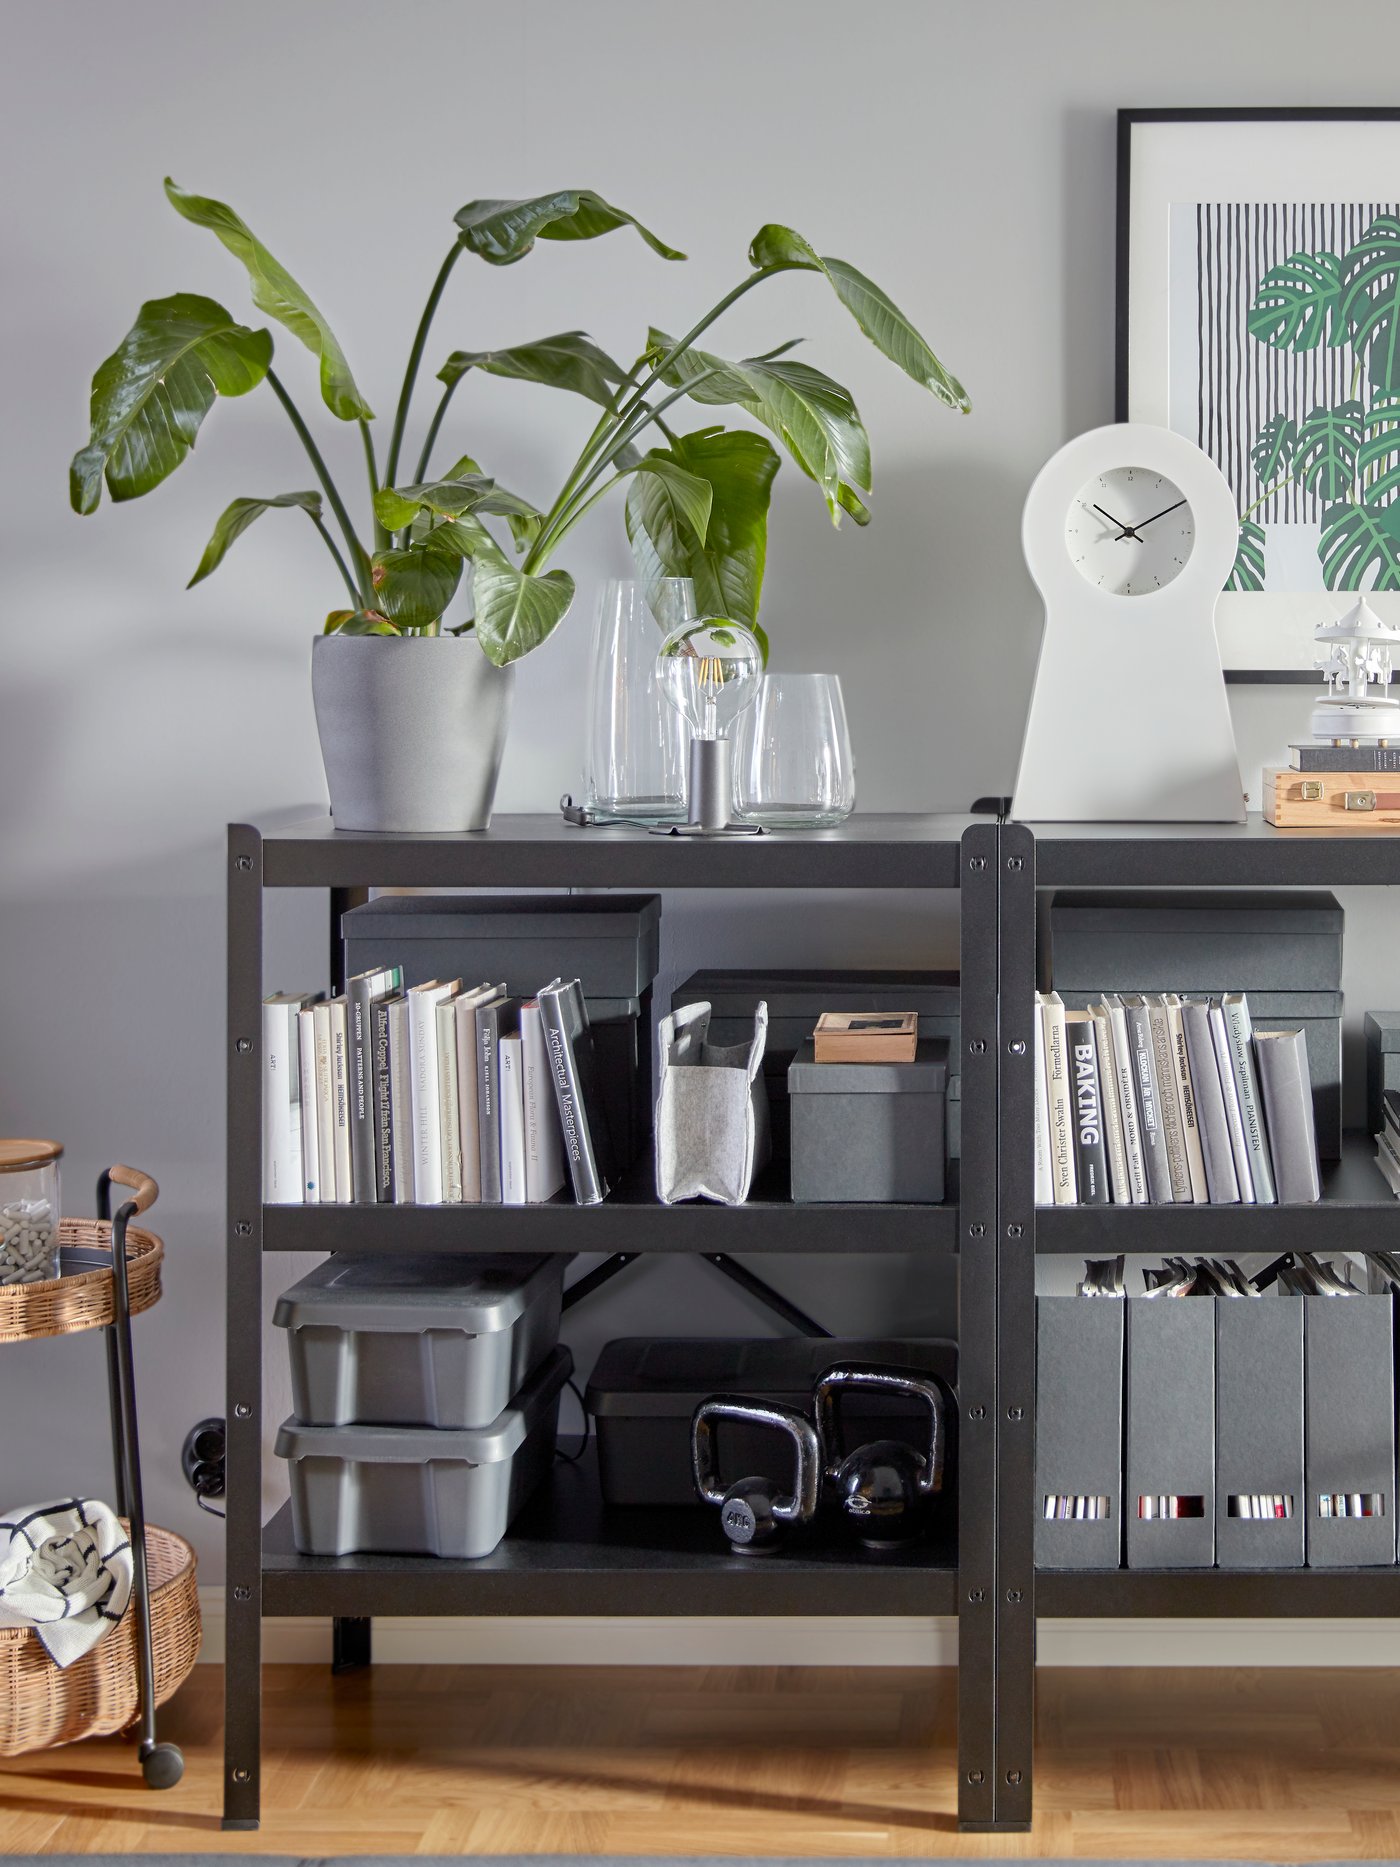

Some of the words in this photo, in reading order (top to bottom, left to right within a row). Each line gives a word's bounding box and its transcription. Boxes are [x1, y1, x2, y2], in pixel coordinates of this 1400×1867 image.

[355, 1002, 363, 1040] 10-GRUPPEN
[378, 1010, 389, 1038] Alfred
[1151, 1018, 1167, 1043] ansikte
[482, 1028, 491, 1045] Följa
[1176, 1033, 1187, 1055] Shirley
[1139, 1052, 1150, 1083] KLOCKAN
[1179, 1056, 1188, 1081] Jackson
[379, 1074, 390, 1100] Flight
[526, 1066, 536, 1100] European
[549, 1028, 570, 1088] Architectual
[561, 1094, 581, 1161] Masterpieces
[1075, 1044, 1099, 1144] BAKING
[1162, 1087, 1174, 1102] och
[380, 1101, 389, 1110] 17
[419, 1106, 428, 1126] HILL
[528, 1102, 537, 1120] Flora
[1055, 1098, 1065, 1127] Swahn
[1127, 1111, 1133, 1119] &
[1144, 1101, 1154, 1127] MYCKET
[1238, 1061, 1252, 1100] Szpilman
[1246, 1105, 1261, 1151] PIANISTEN
[381, 1128, 390, 1145] San
[1128, 1121, 1137, 1145] MORD
[420, 1130, 429, 1166] WINTER
[1057, 1129, 1068, 1165] Christer
[1132, 1153, 1140, 1170] Falk
[1059, 1166, 1069, 1187] Sven
[1133, 1171, 1143, 1194] Bertil
